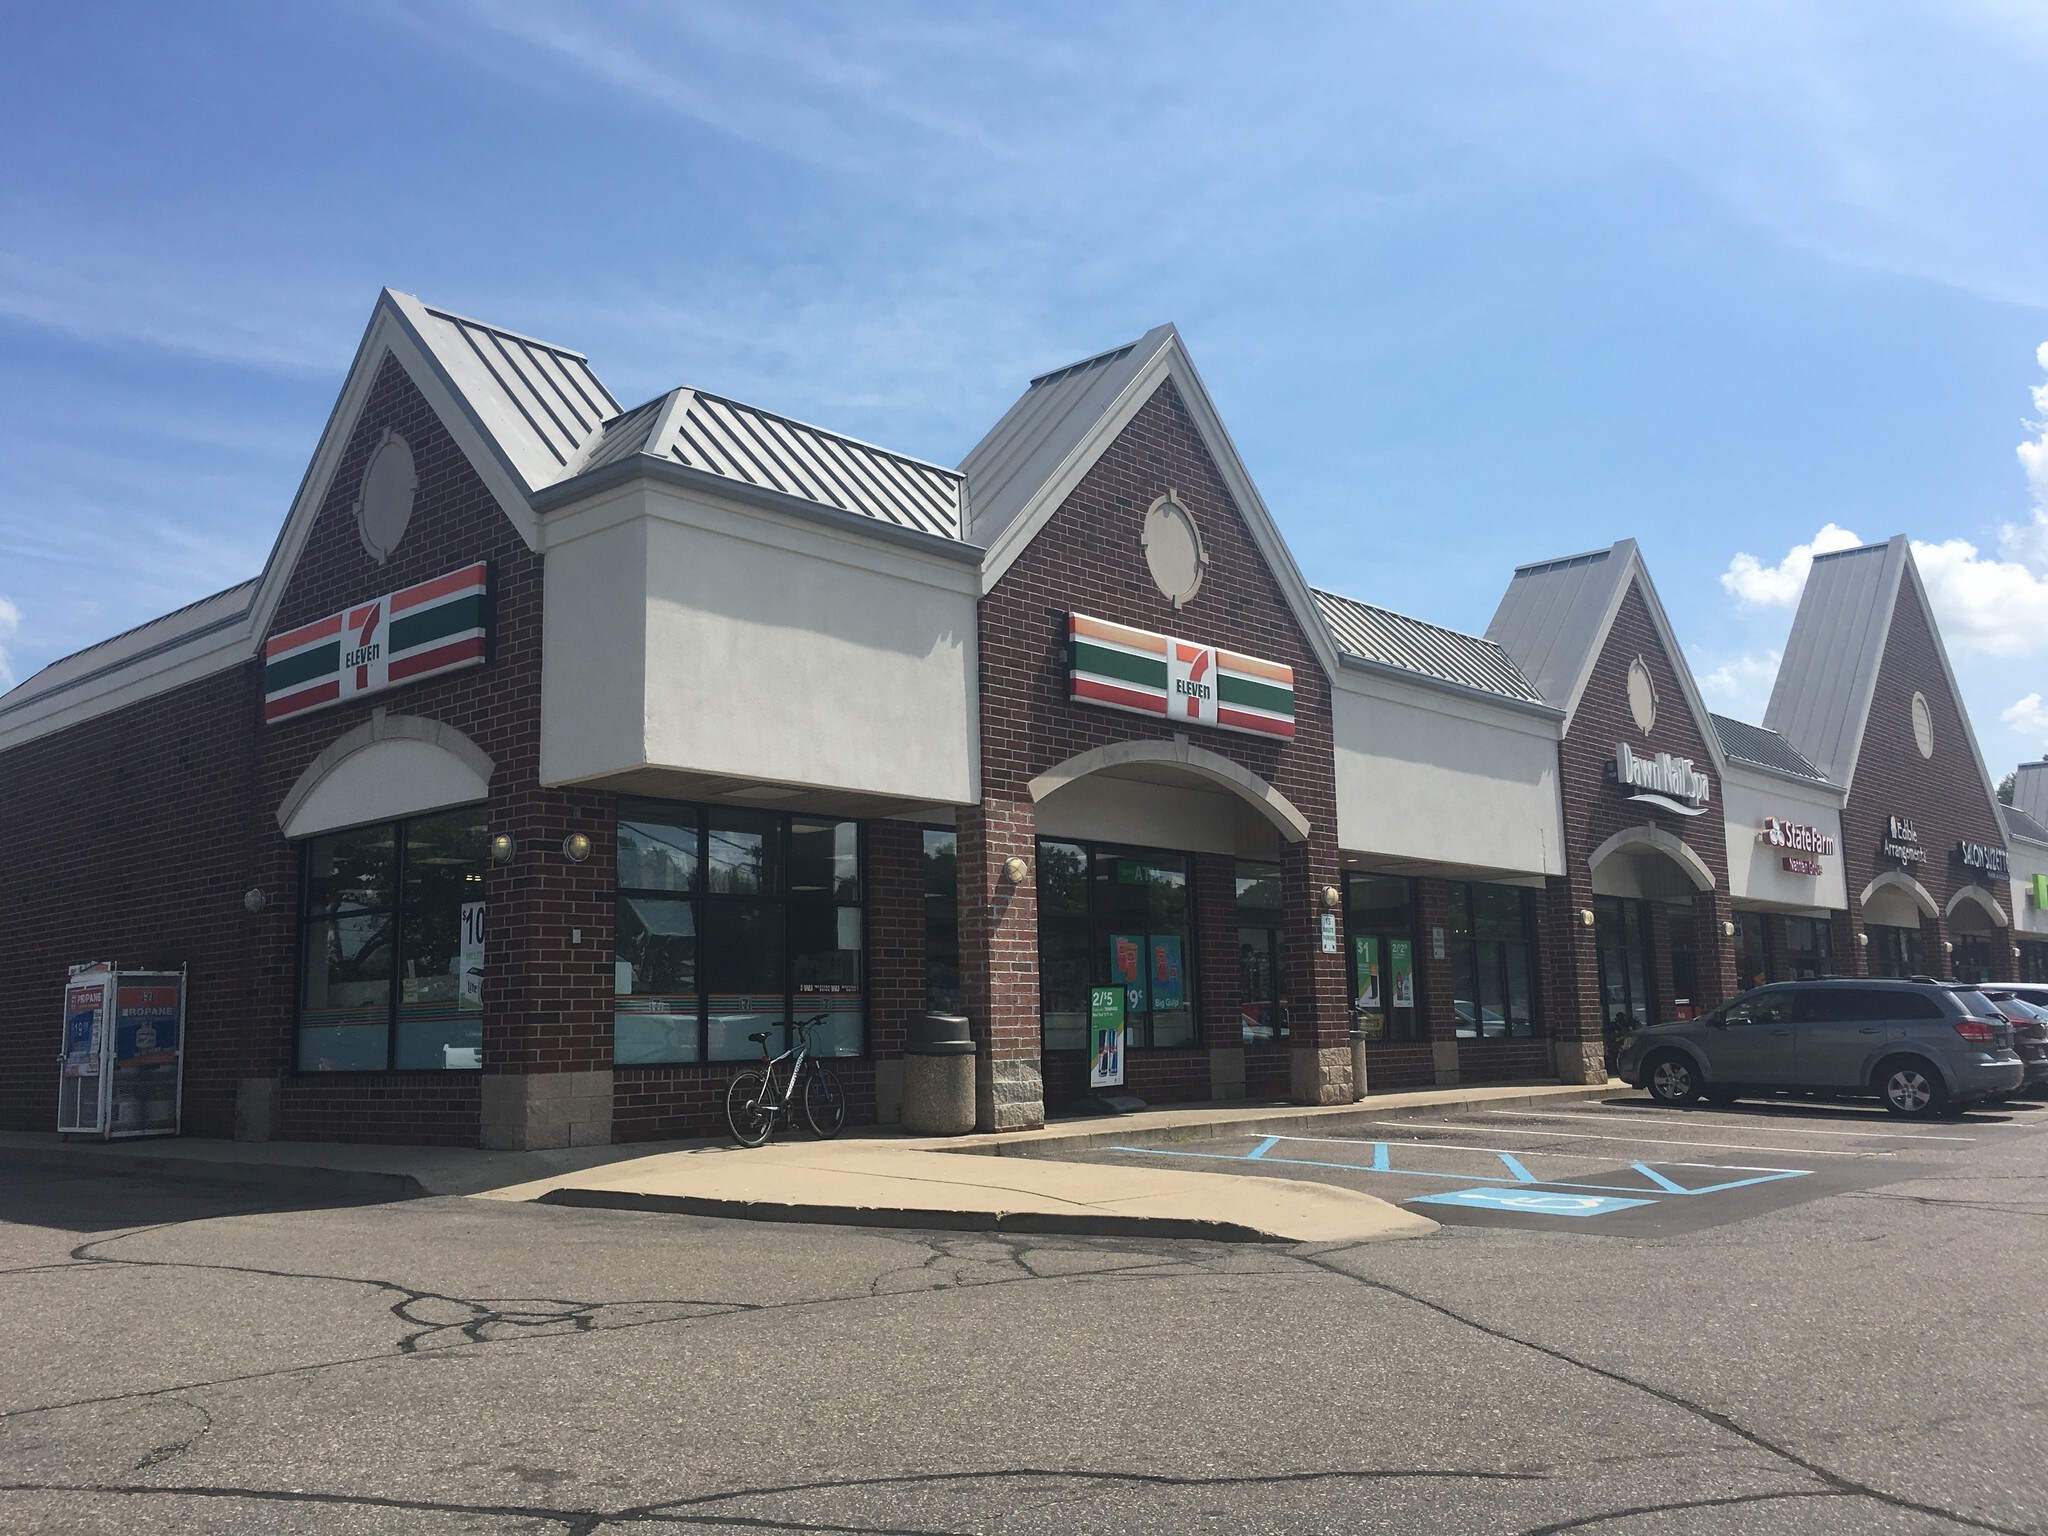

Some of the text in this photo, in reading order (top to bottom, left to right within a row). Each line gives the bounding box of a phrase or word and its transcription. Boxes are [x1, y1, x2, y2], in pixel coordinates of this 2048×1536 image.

[348, 601, 381, 691] 7
[1176, 642, 1209, 718] 7
[1618, 742, 1710, 807] Dawn Nail Spa
[1896, 818, 1918, 843] Edible
[1883, 838, 1928, 866] Arrangements
[1962, 840, 1985, 868] SALON
[1127, 989, 1143, 1009] 9¢
[1155, 998, 1179, 1008] Big Gulp
